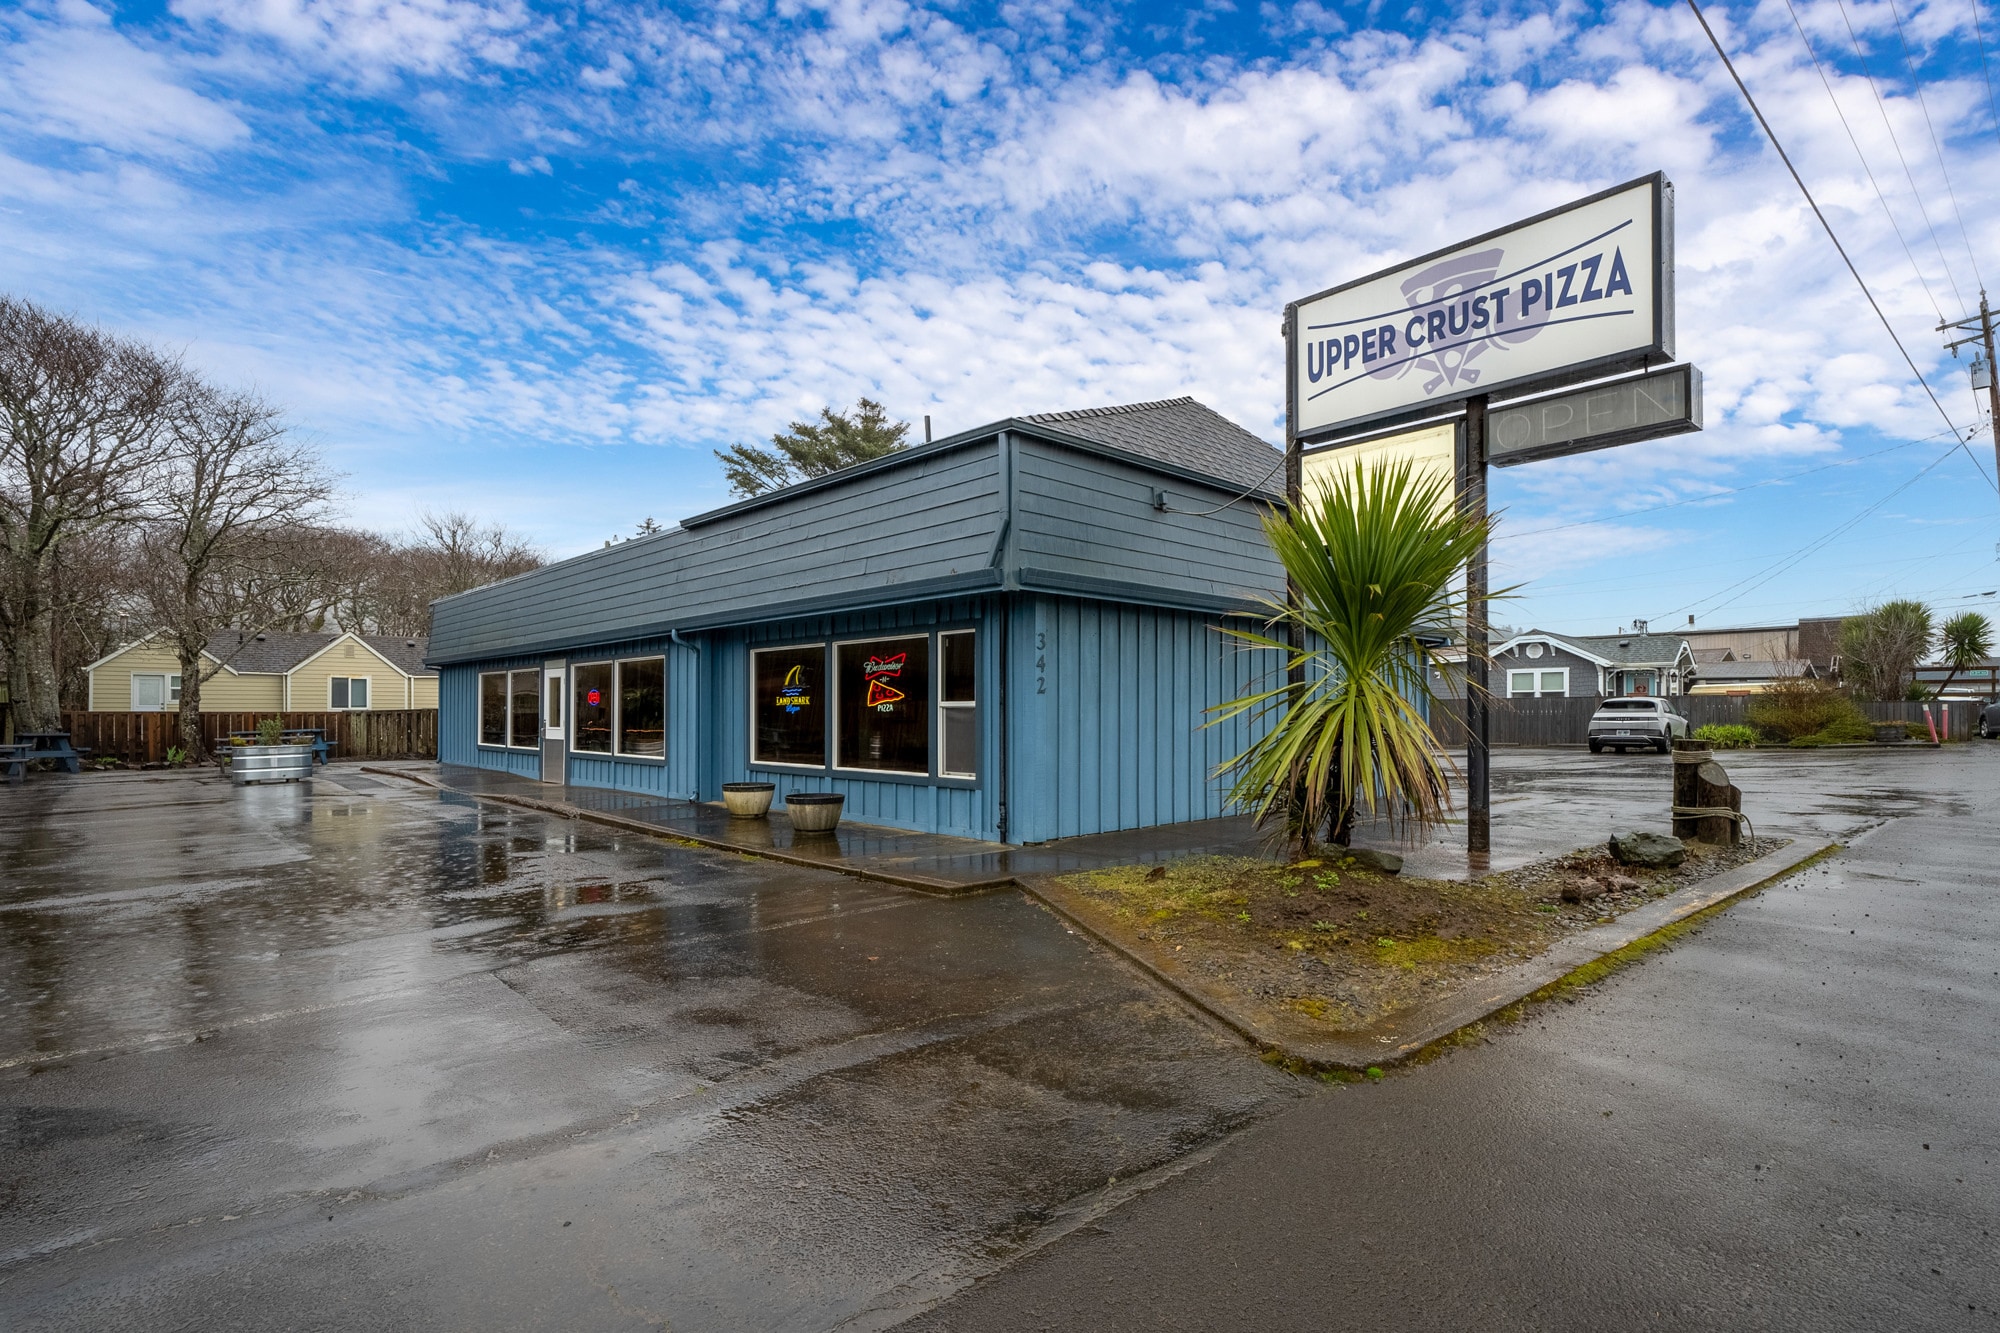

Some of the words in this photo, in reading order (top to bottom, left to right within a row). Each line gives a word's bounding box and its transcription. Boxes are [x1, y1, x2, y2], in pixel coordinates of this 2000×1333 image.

[1307, 324, 1397, 384] UPPER
[1405, 287, 1510, 348] CRUST
[1521, 245, 1633, 317] PIZZA
[1496, 379, 1676, 449] OPEN
[1035, 632, 1047, 695] 342
[877, 704, 894, 712] PIZZA
